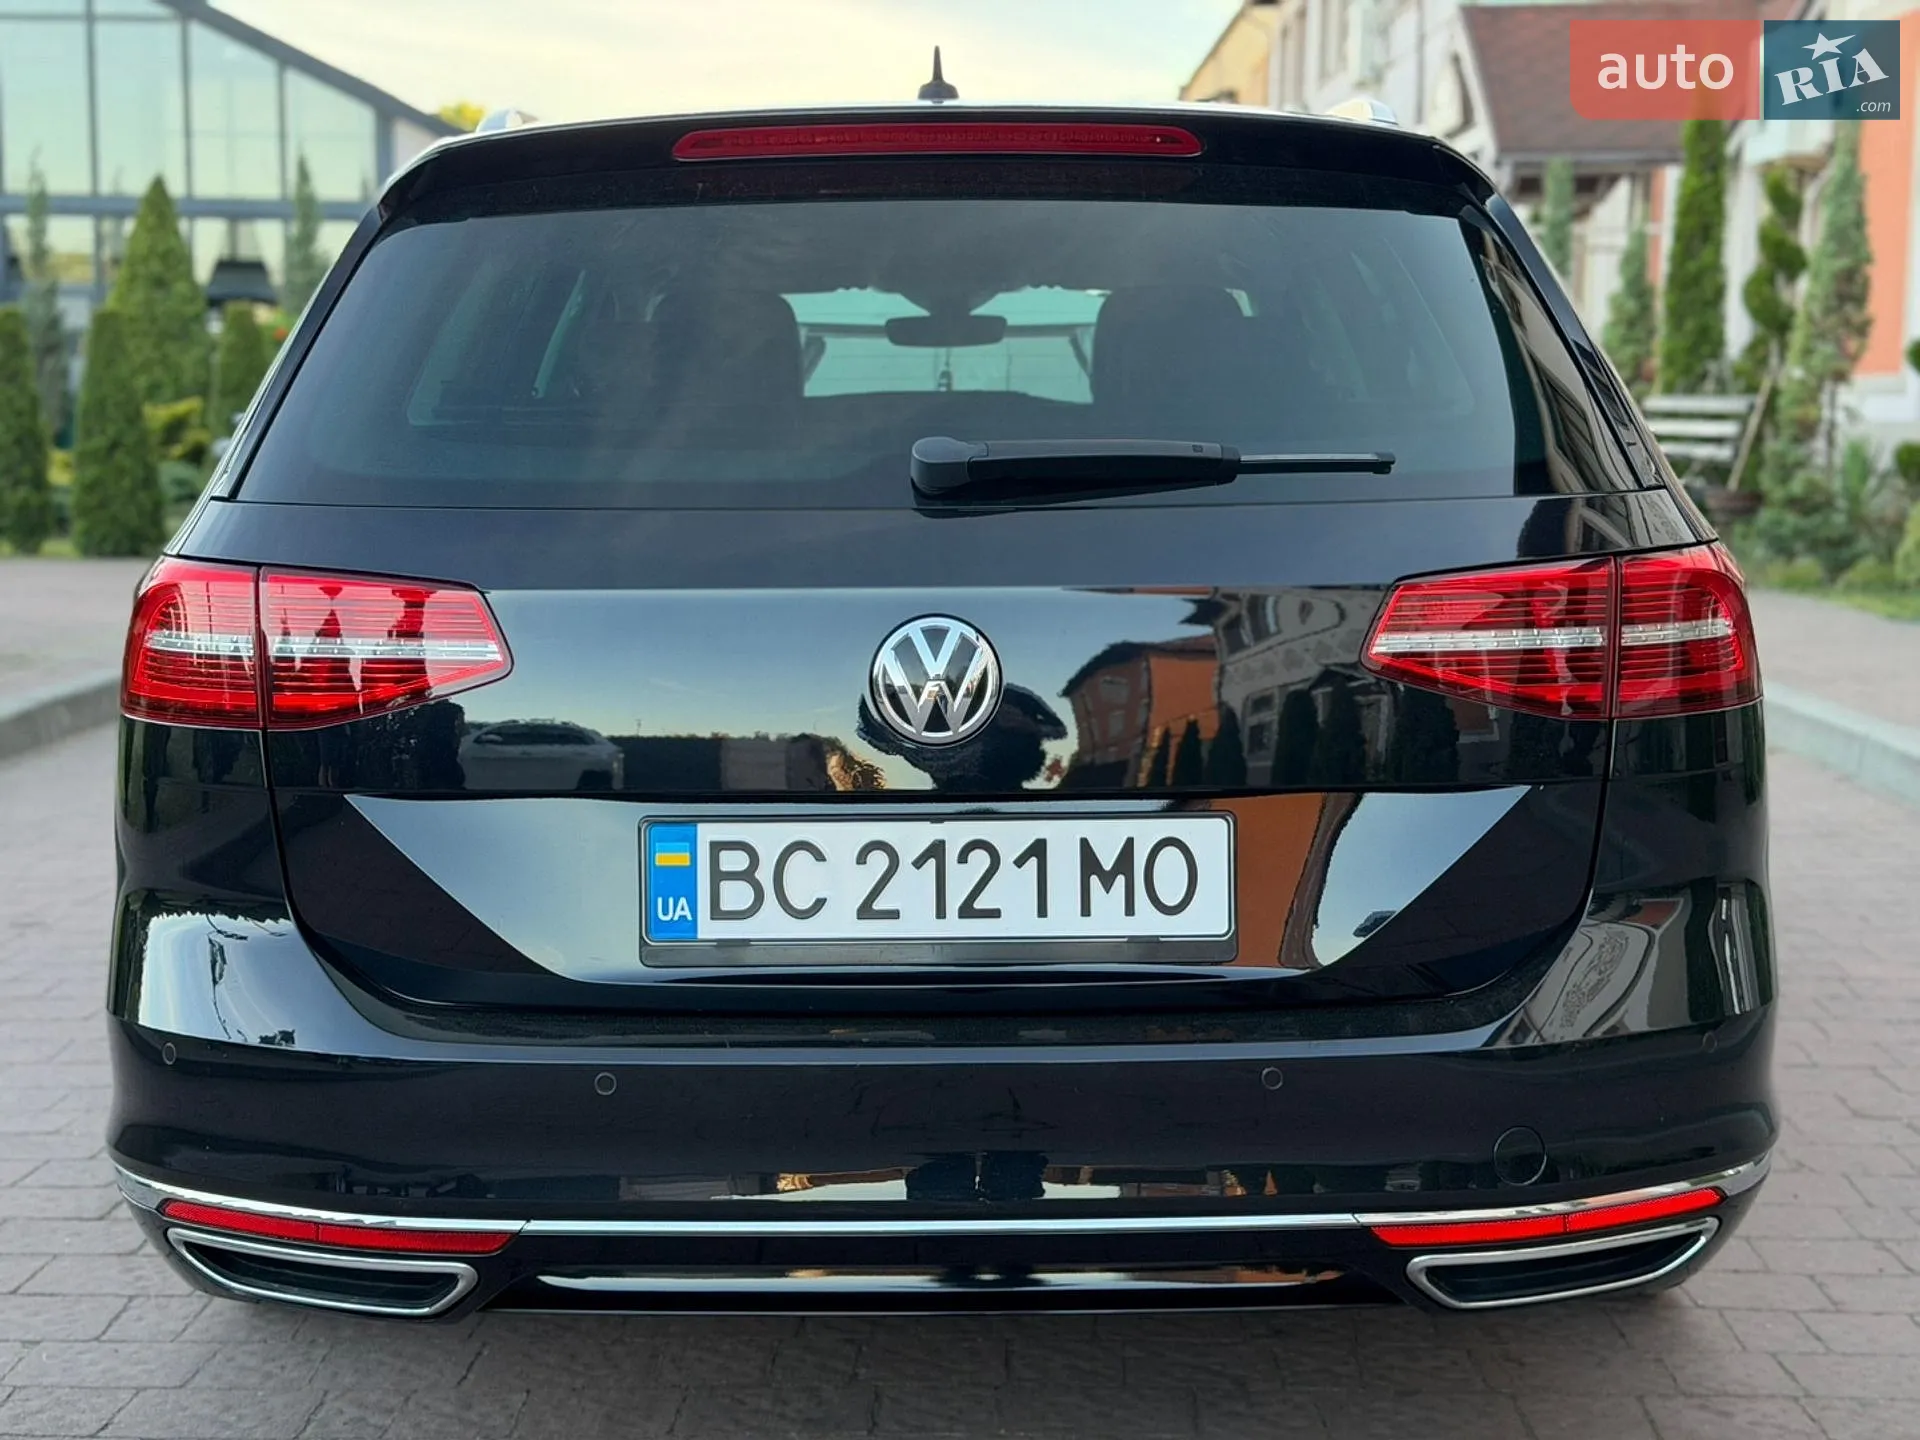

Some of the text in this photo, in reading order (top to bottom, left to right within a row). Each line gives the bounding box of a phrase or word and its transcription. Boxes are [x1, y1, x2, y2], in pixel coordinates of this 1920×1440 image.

[709, 836, 1198, 921] BC 2121 MO
[657, 897, 692, 921] UA
